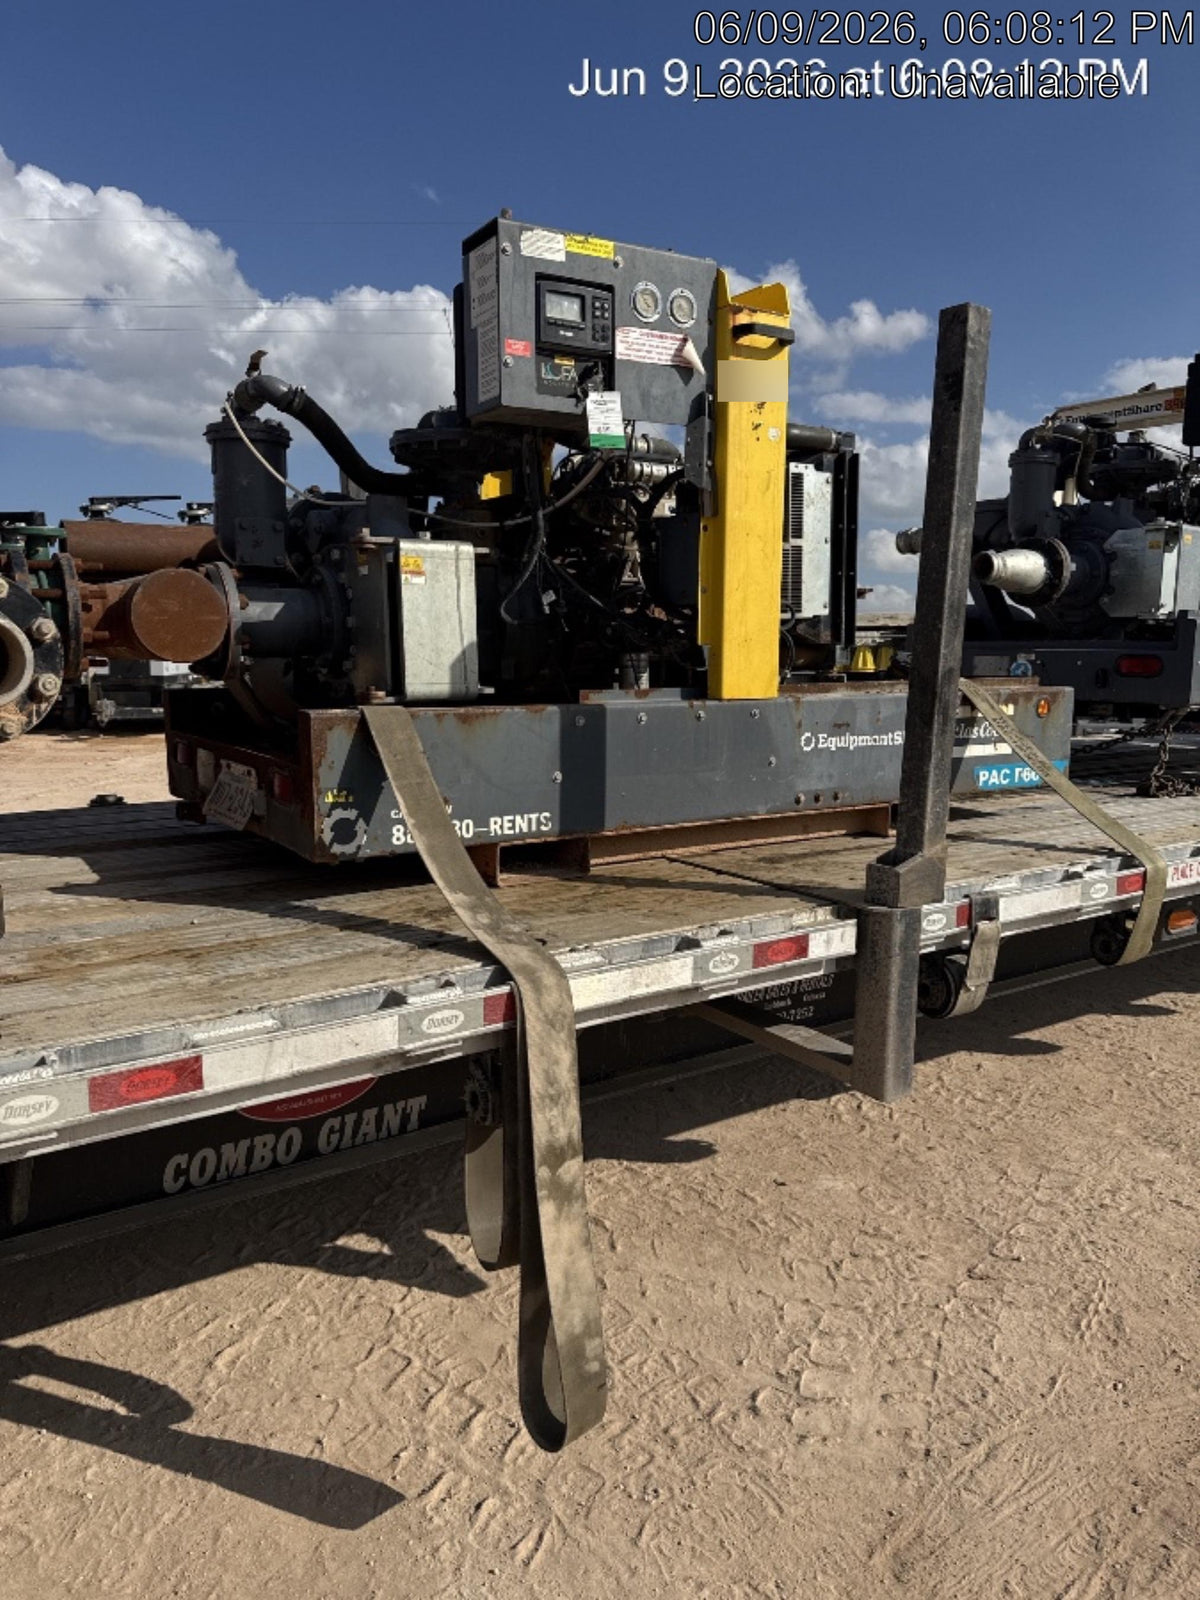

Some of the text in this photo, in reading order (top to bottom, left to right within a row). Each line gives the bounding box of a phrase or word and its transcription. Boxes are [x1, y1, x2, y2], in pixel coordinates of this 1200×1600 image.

[979, 769, 1010, 787] PAC
[162, 1095, 427, 1194] COMBO GIANT
